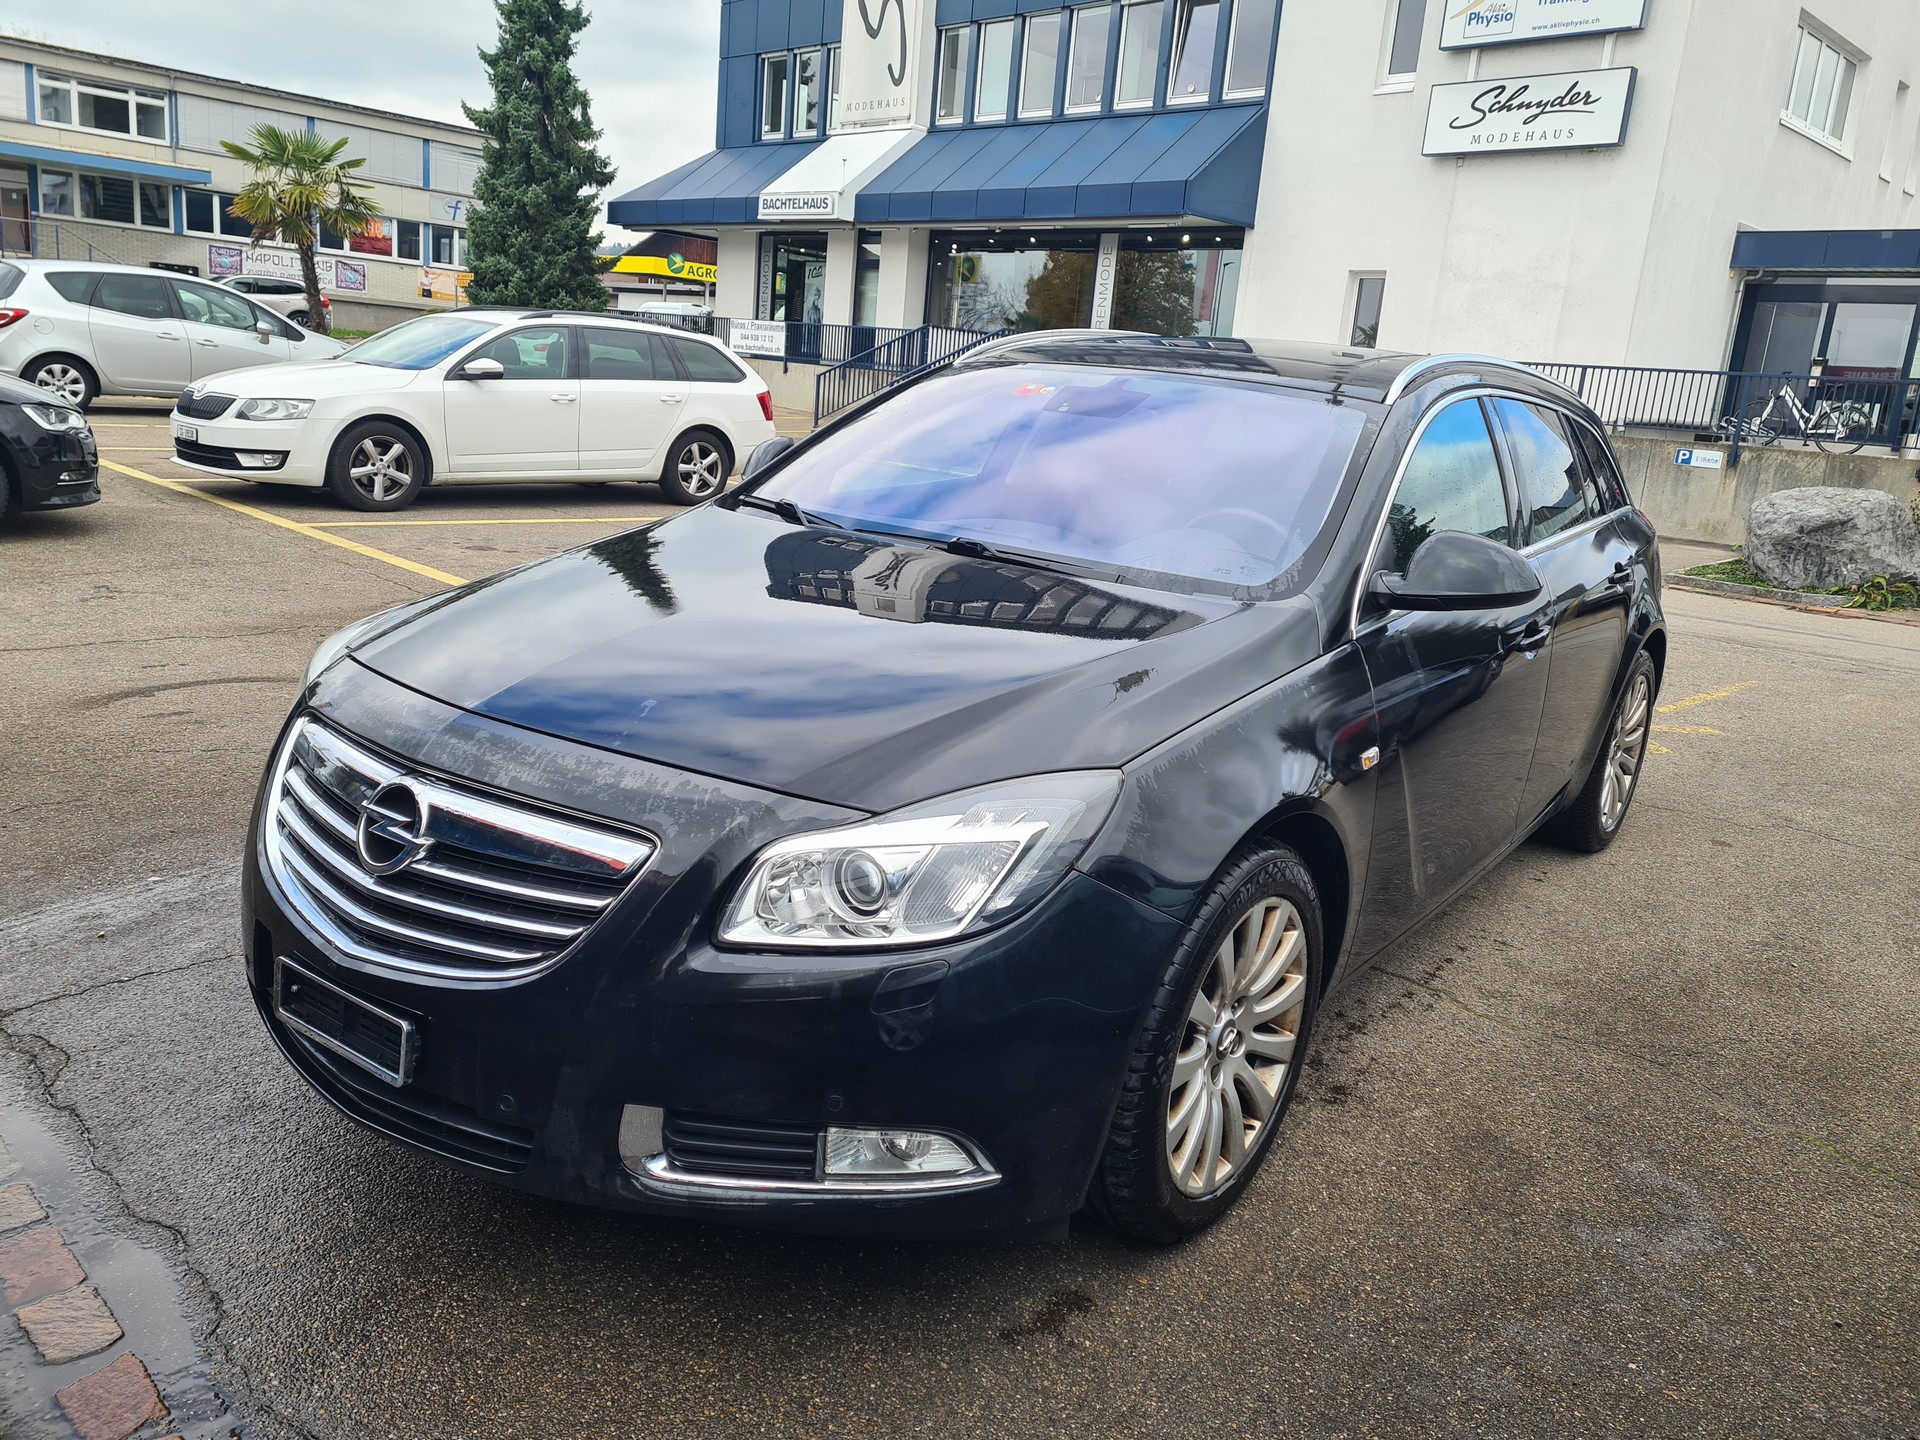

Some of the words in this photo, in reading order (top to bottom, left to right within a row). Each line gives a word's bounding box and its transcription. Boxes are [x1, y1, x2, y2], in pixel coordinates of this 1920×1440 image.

[1467, 11, 1514, 28] Physio
[1531, 17, 1601, 31] www.aktivphysio.ch
[845, 97, 906, 112] MODEHAUS
[1449, 80, 1602, 129] Schnyder
[1469, 128, 1575, 145] MODEHAUS
[762, 197, 829, 210] BACHTELHAUS
[246, 252, 295, 268] NAPOLI
[760, 245, 771, 320] AMENMODE
[1095, 246, 1113, 329] RENMODE
[740, 333, 750, 341] 044
[750, 334, 760, 342] 938
[767, 335, 774, 343] 12
